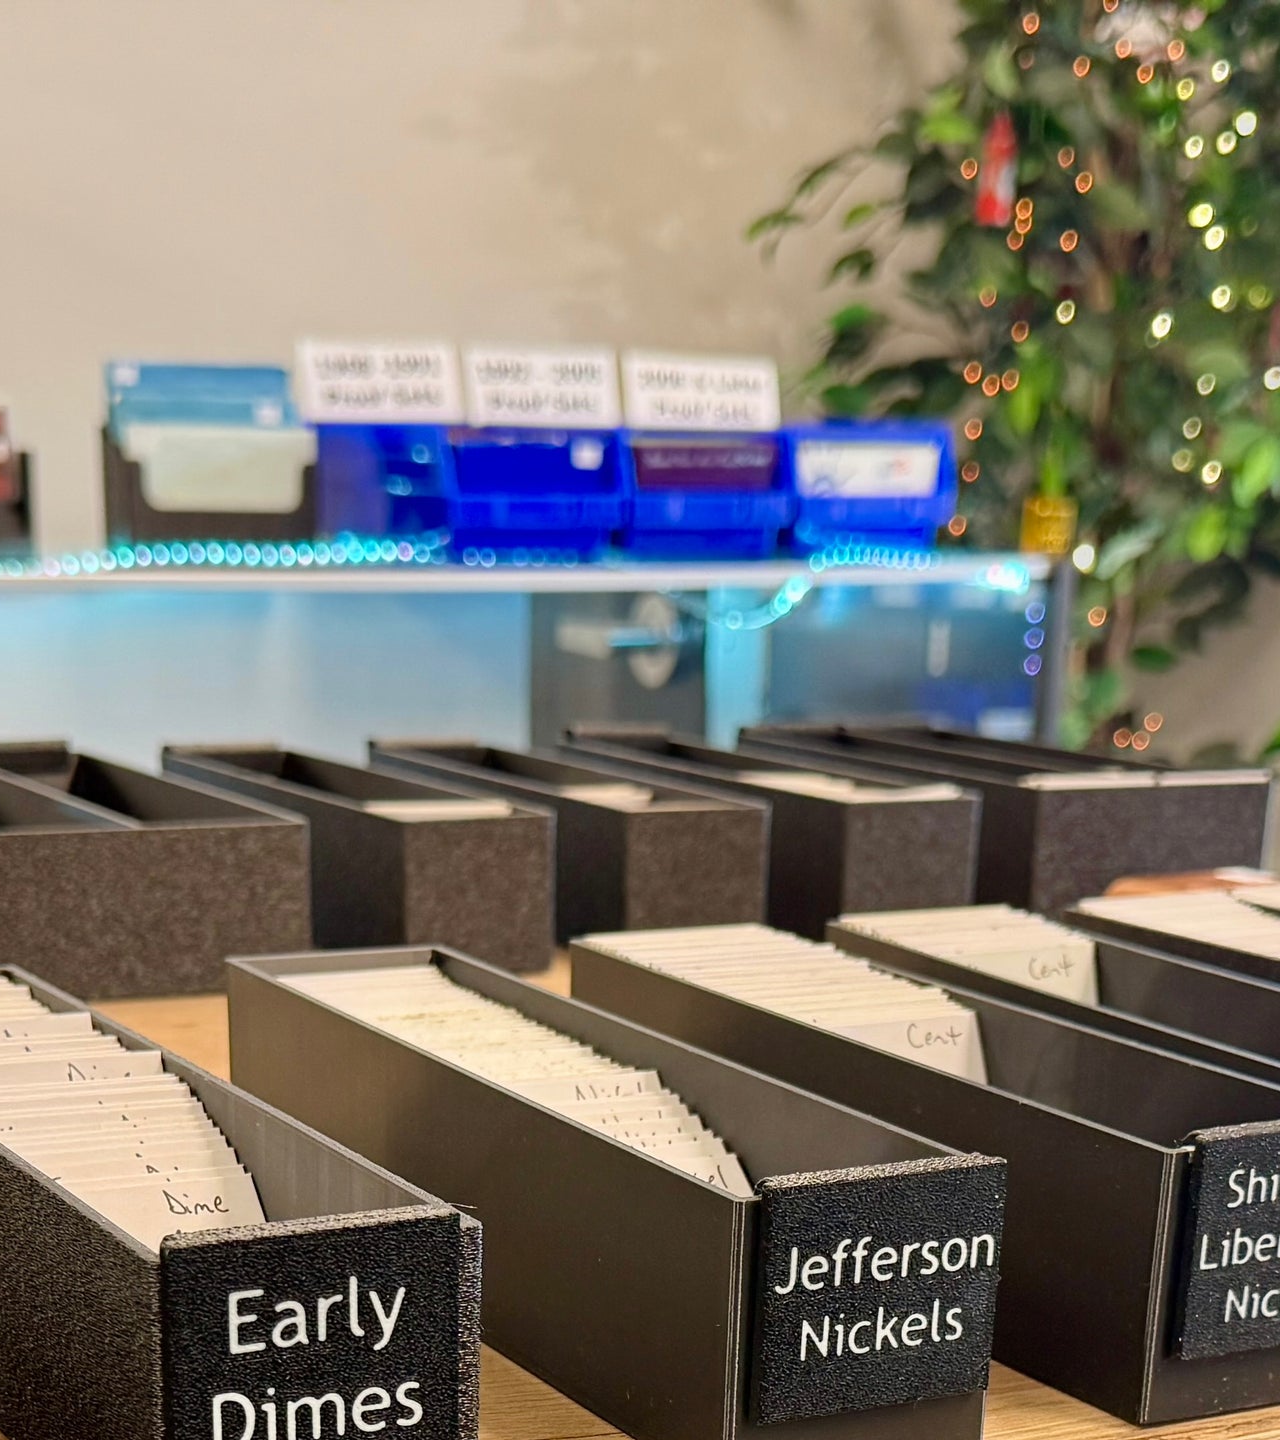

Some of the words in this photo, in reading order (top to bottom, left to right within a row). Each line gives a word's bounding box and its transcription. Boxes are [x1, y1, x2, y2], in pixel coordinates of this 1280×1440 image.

[907, 1022, 962, 1049] Cent
[161, 1188, 230, 1215] Dime
[774, 1233, 995, 1295] Jefferson
[228, 1275, 406, 1354] Early
[800, 1298, 963, 1362] Nickels
